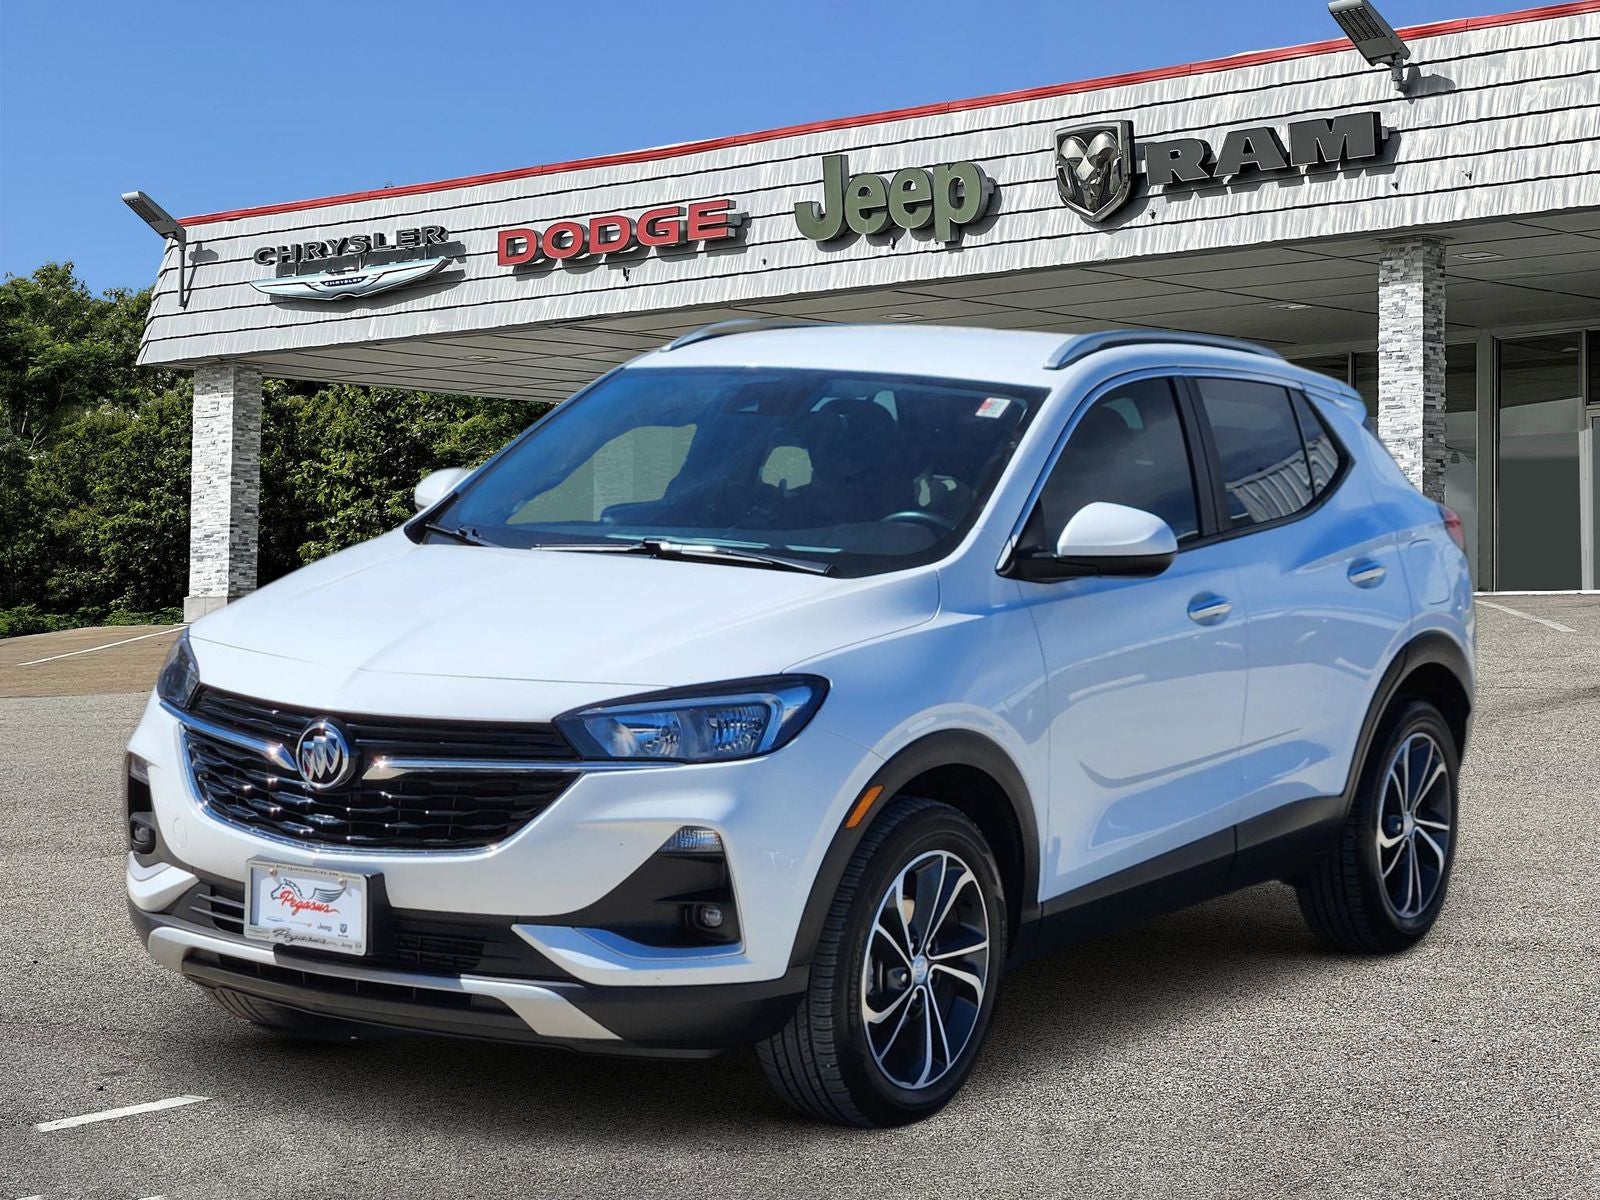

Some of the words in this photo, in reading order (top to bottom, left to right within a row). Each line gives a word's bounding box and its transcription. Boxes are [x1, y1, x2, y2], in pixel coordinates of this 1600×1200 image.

[1146, 112, 1381, 186] RAM
[795, 154, 994, 242] Jeep
[252, 225, 449, 266] CHRYSLER
[497, 199, 736, 266] DODGE
[325, 277, 362, 286] CHRYSLER
[280, 890, 341, 916] Pegasus
